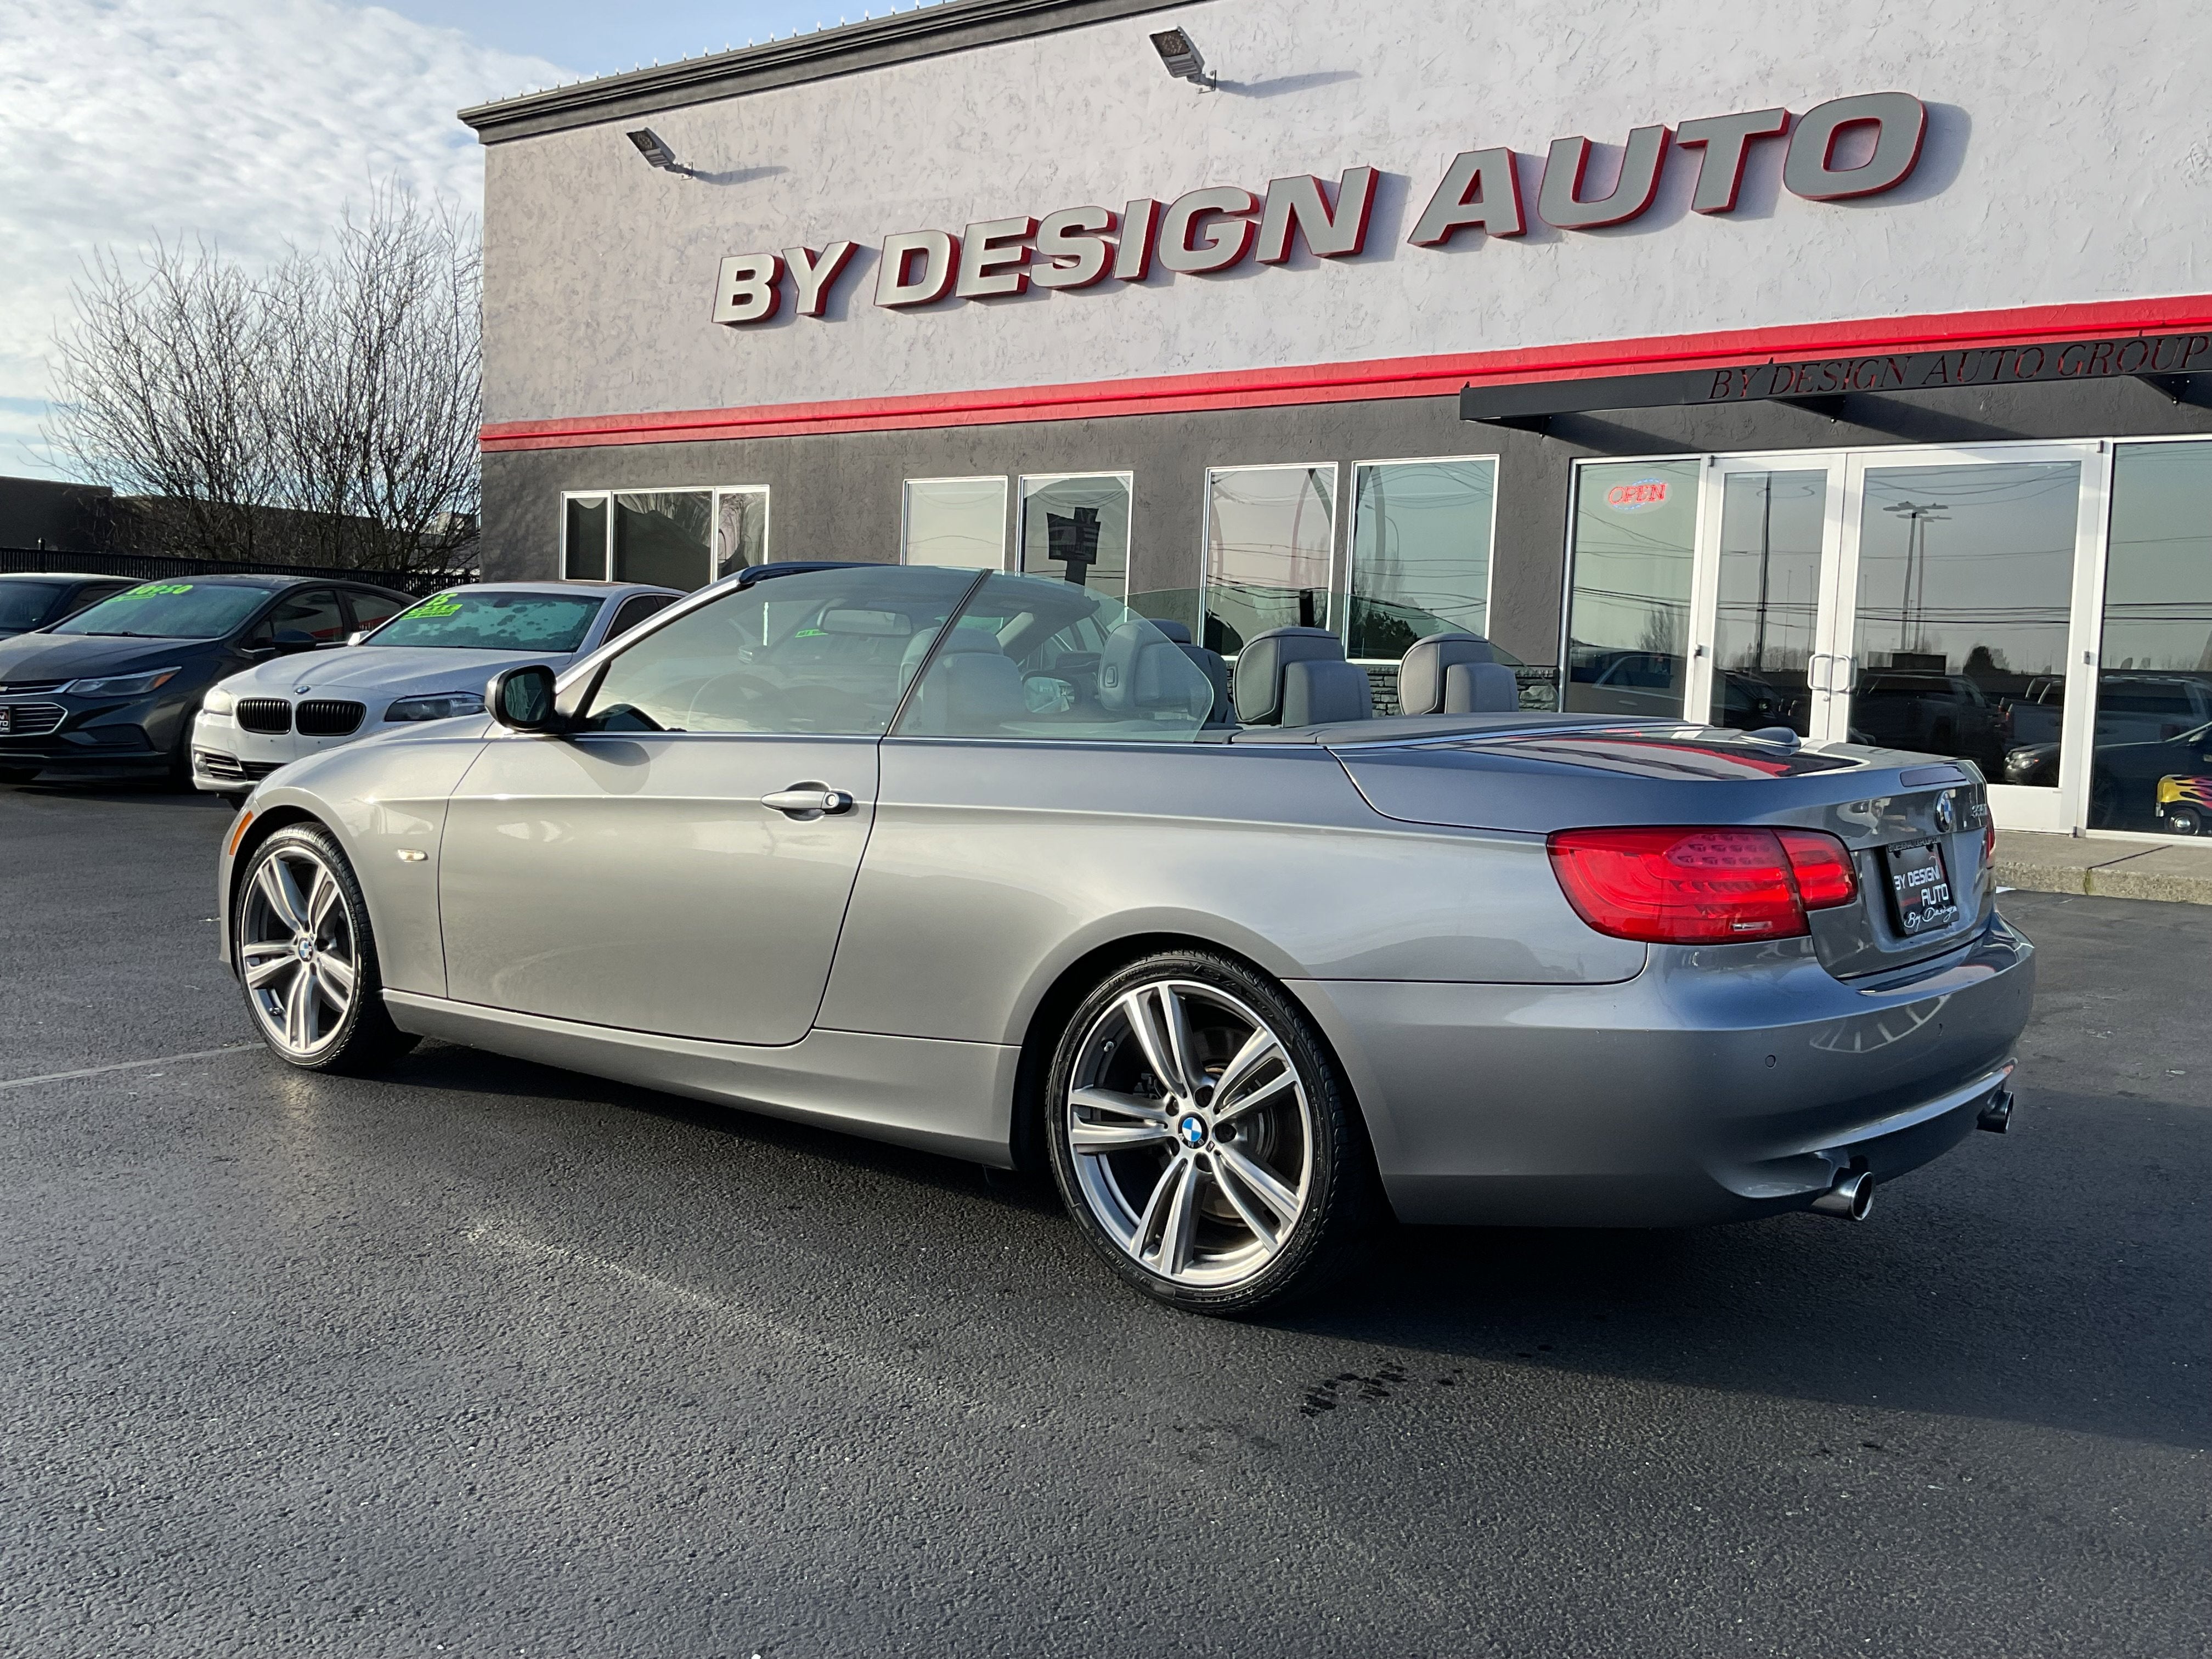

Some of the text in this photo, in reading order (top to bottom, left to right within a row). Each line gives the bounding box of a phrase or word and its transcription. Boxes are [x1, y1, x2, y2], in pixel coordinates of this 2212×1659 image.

[712, 92, 1928, 326] BY DESIGN AUTO
[1708, 335, 2210, 399] BY DESIGN AUTO GROUP
[1609, 483, 1667, 505] OPEN
[1907, 866, 1940, 887] DESIGN
[1921, 883, 1949, 907] AUTO
[1903, 906, 1957, 933] By Design
